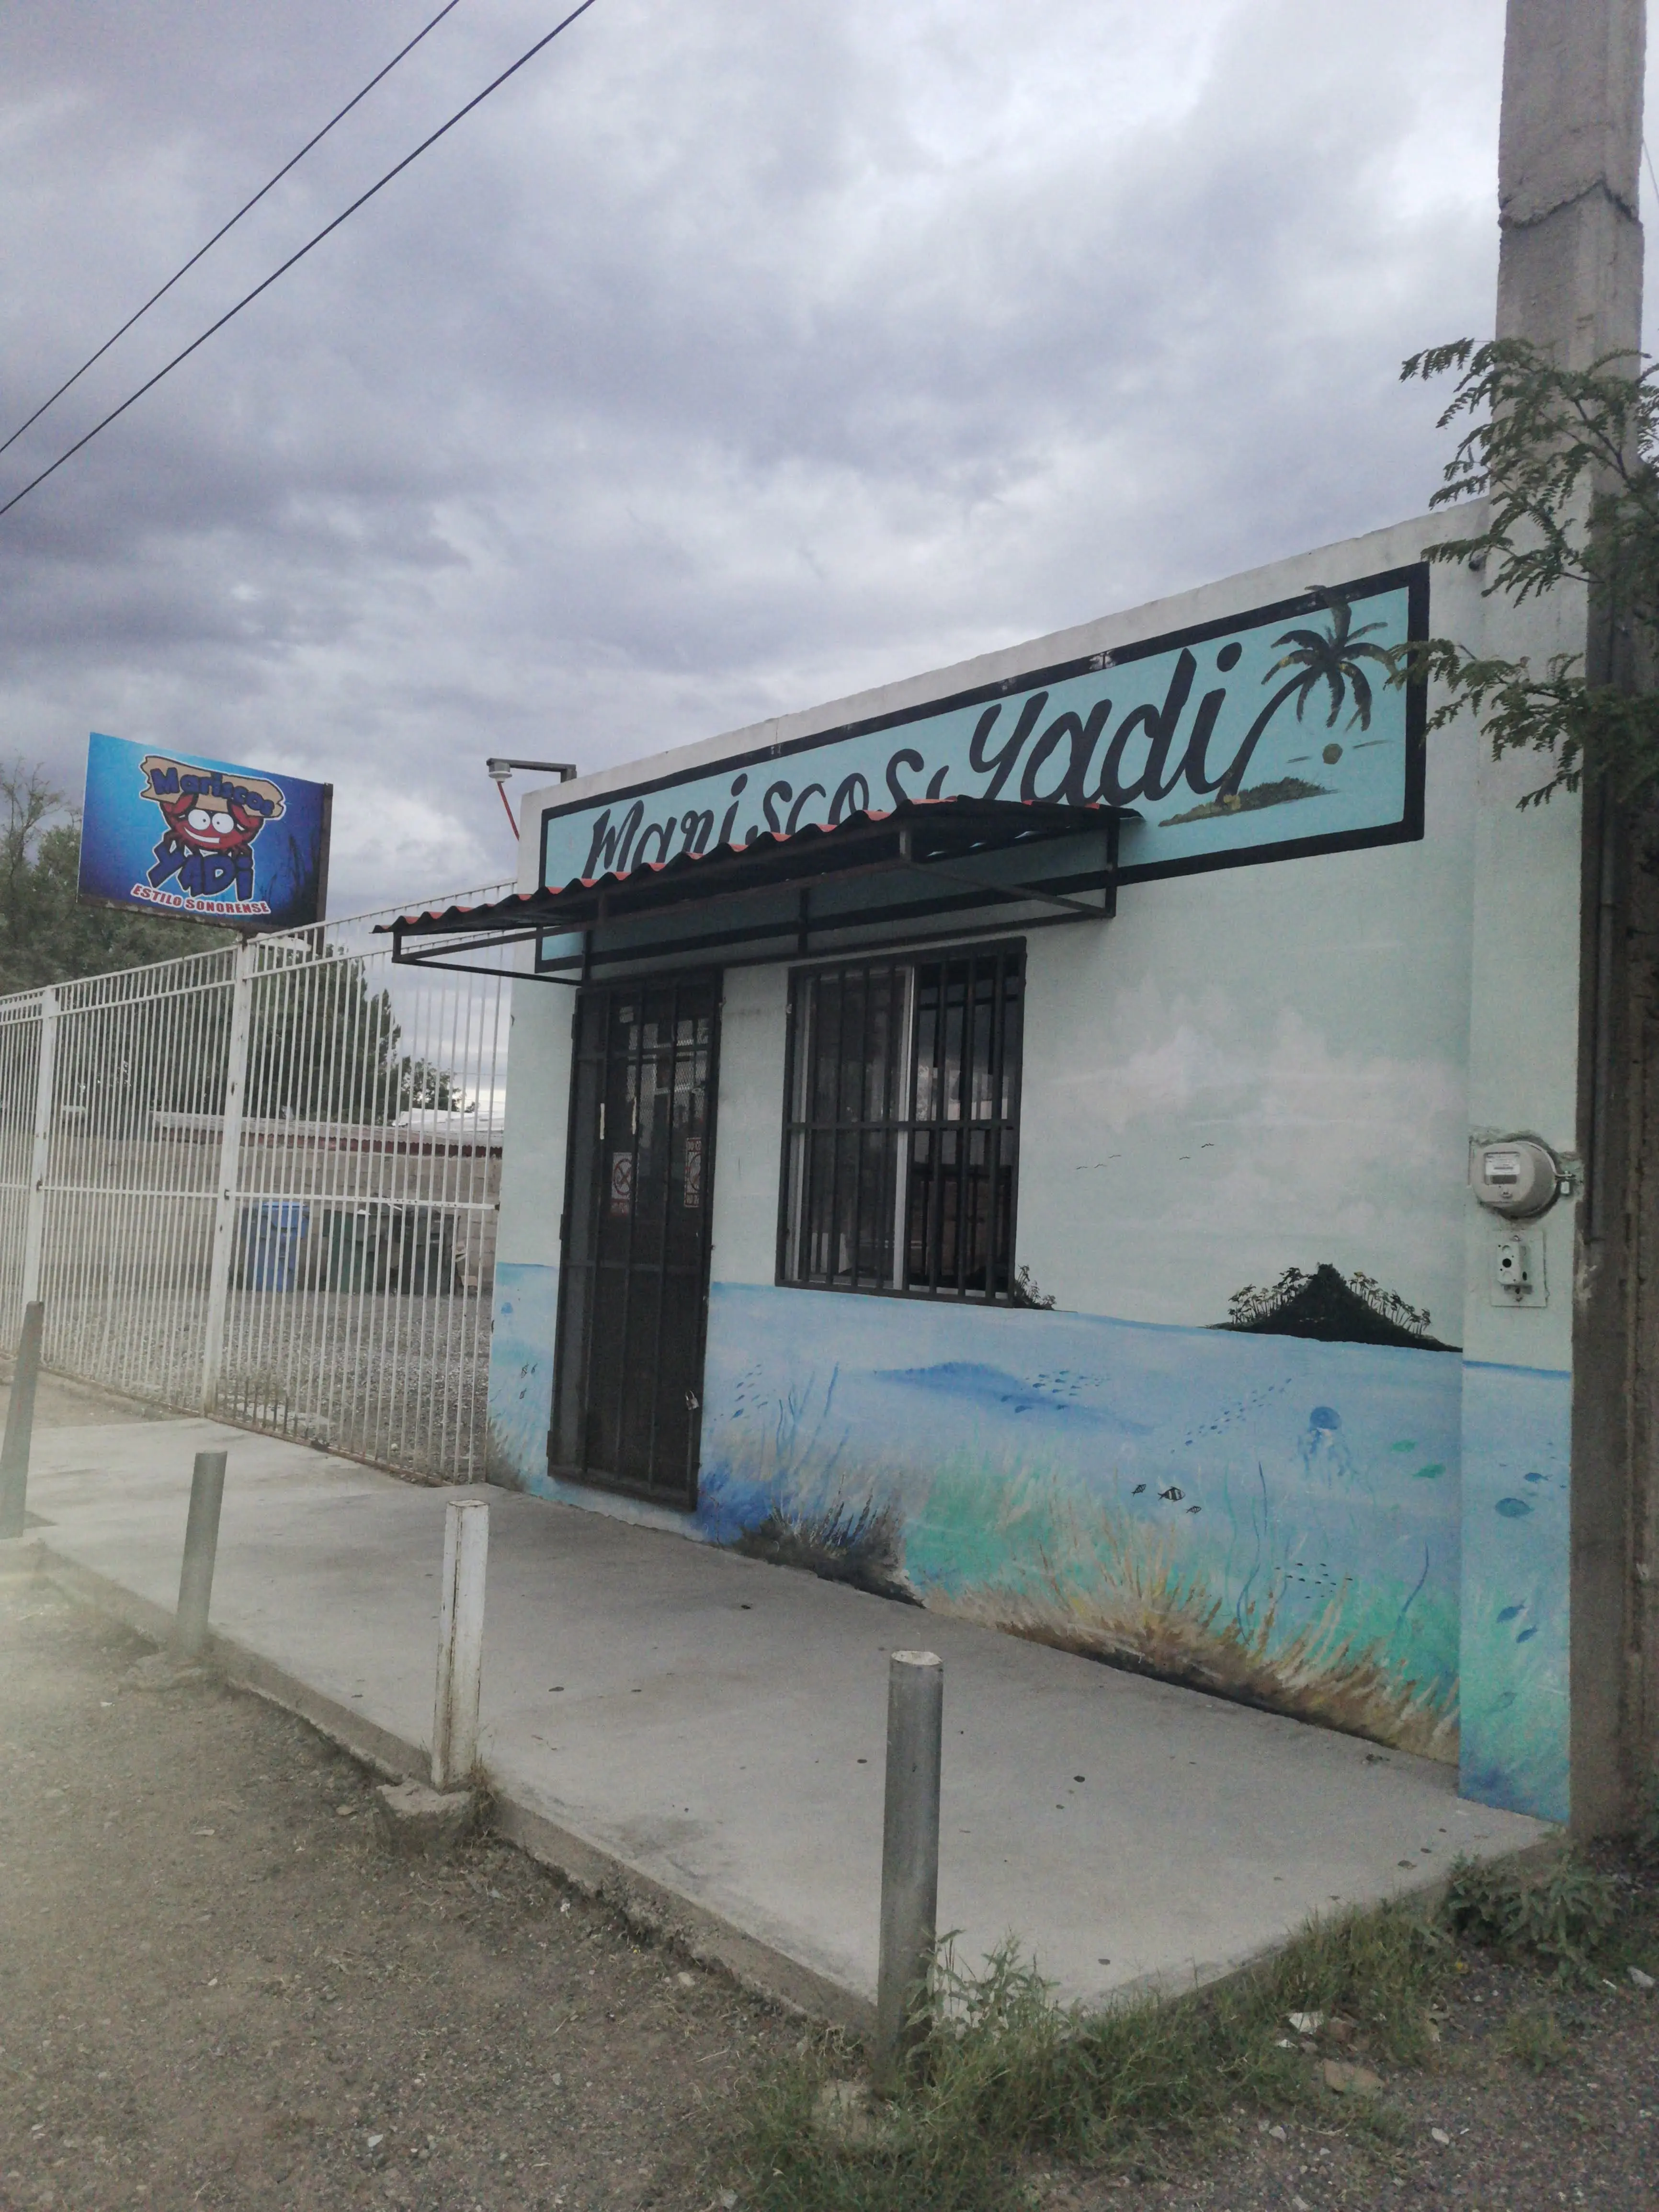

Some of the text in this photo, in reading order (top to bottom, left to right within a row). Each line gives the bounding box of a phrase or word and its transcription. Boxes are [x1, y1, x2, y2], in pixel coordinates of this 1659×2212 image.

[582, 642, 1242, 879] Mariscos Yadi
[149, 767, 275, 816] Mariscos
[133, 885, 269, 914] ESTILO SONORENSE
